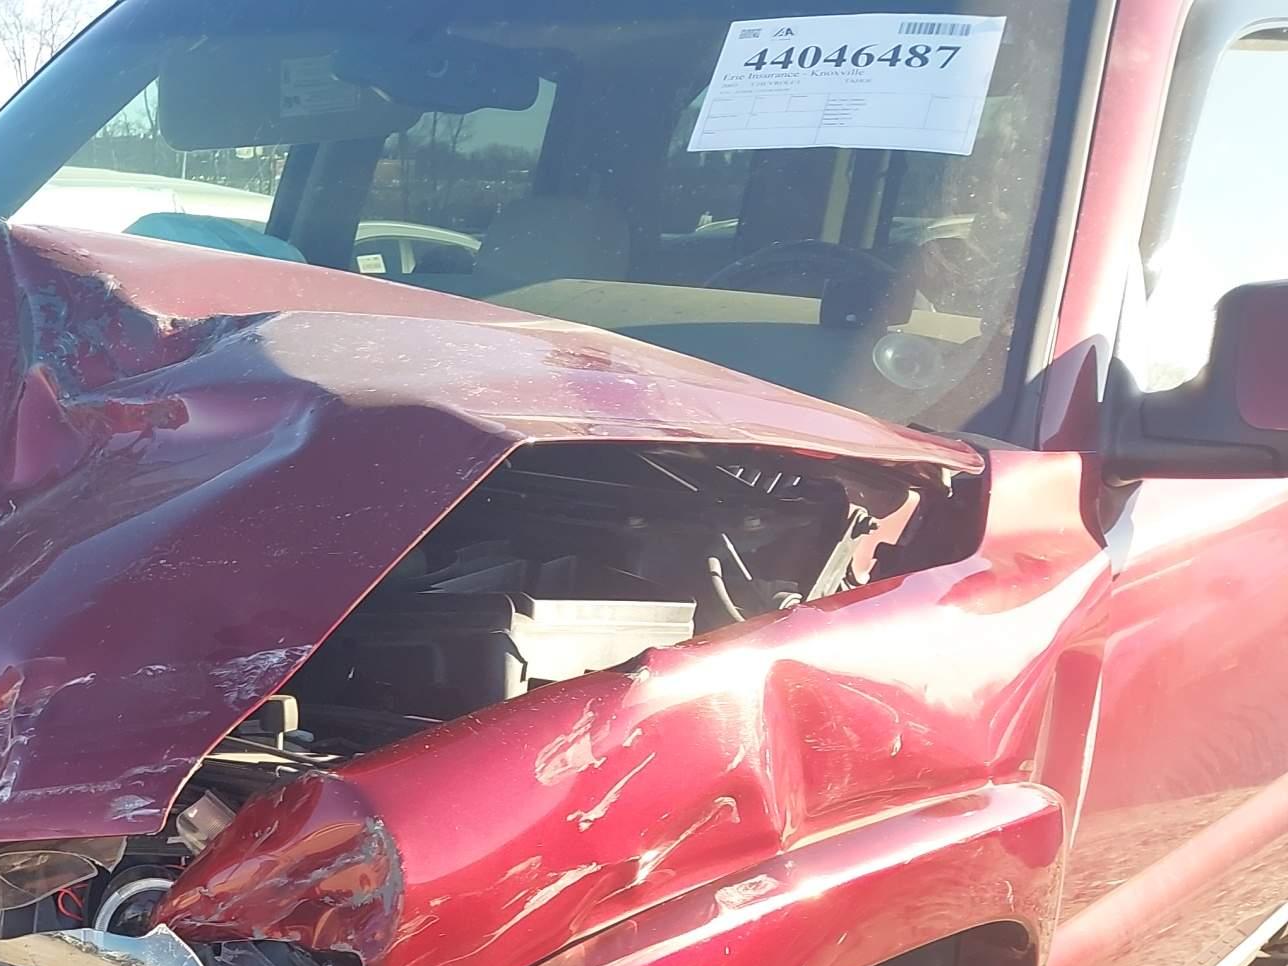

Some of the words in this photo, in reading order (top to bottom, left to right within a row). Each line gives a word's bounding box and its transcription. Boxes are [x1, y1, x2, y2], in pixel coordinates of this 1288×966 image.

[744, 44, 962, 70] 44046487
[748, 71, 801, 80] Insurance
[810, 68, 865, 77] Knoxville
